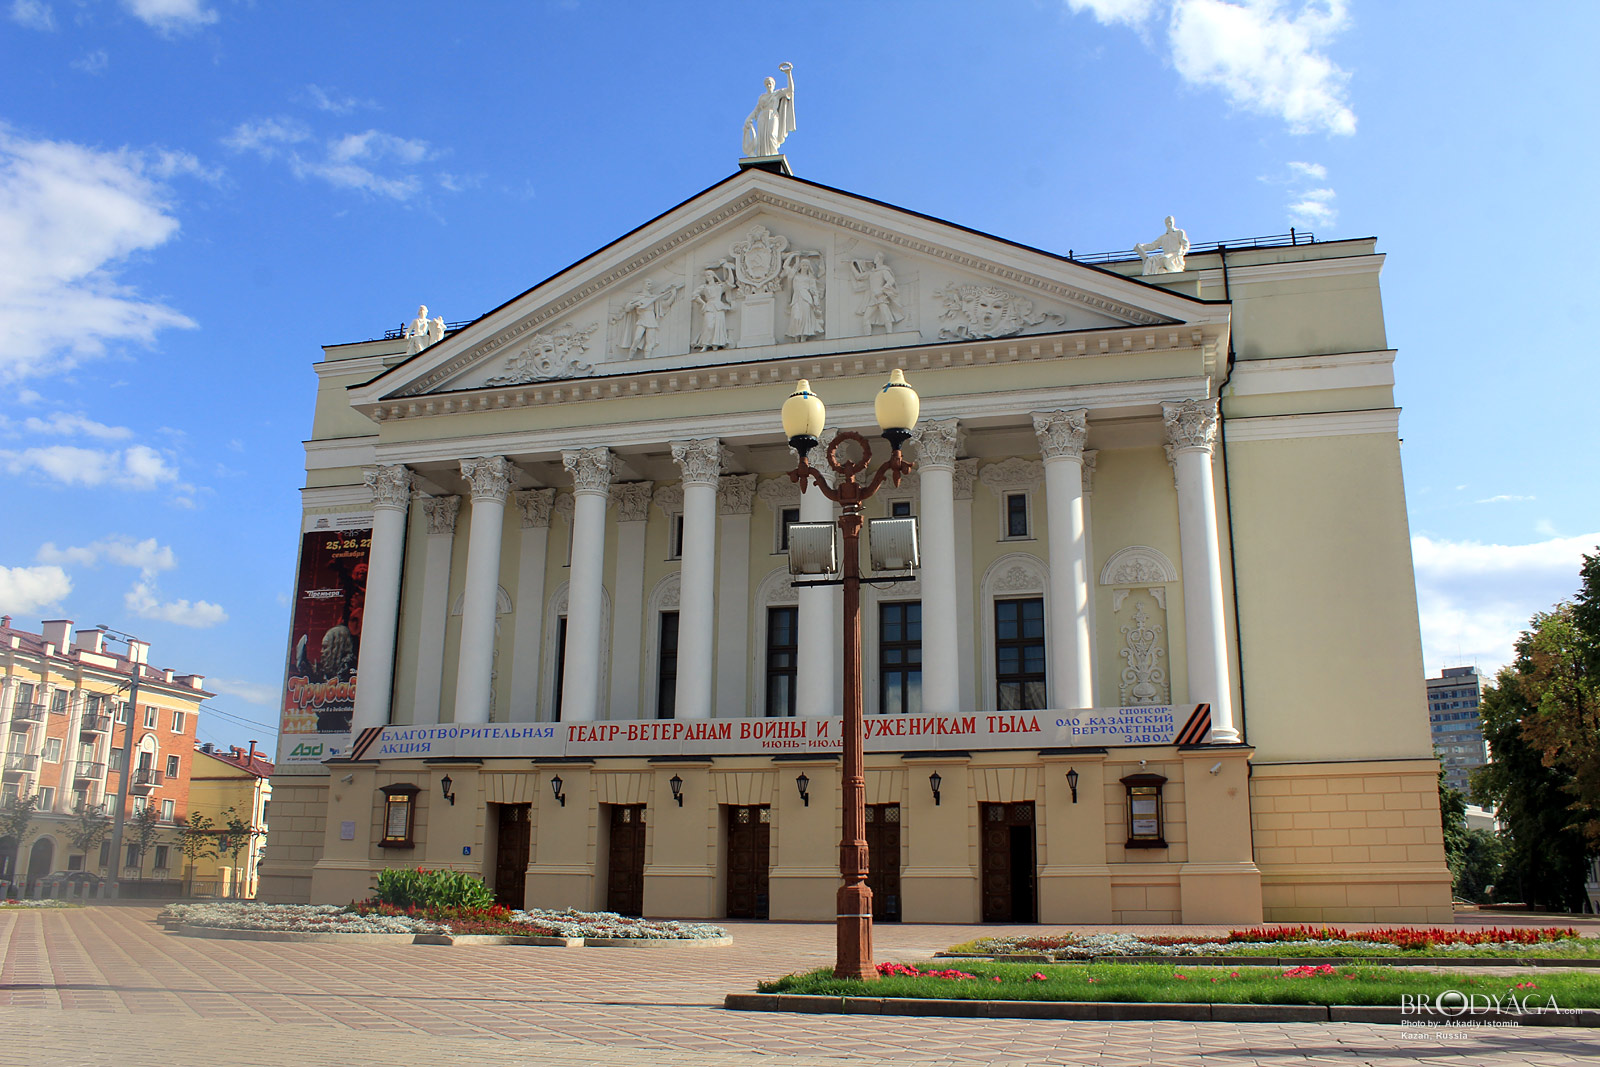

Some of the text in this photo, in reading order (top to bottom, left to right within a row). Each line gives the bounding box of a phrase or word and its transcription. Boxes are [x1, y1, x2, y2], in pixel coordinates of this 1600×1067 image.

[325, 541, 342, 551] 25,
[343, 538, 359, 549] 26,
[1119, 707, 1172, 715] СПОНСОР-
[740, 719, 807, 739] ВОЙНЫ
[816, 720, 829, 738] И
[839, 716, 977, 740] ТУЖЕНИКАМ
[986, 714, 1042, 734] ТЫЛА
[1056, 718, 1080, 727] ОАО
[381, 727, 555, 741] БЛАГОТВОРИТЕЛЬНАЯ
[379, 742, 431, 754] АКЦИЯ
